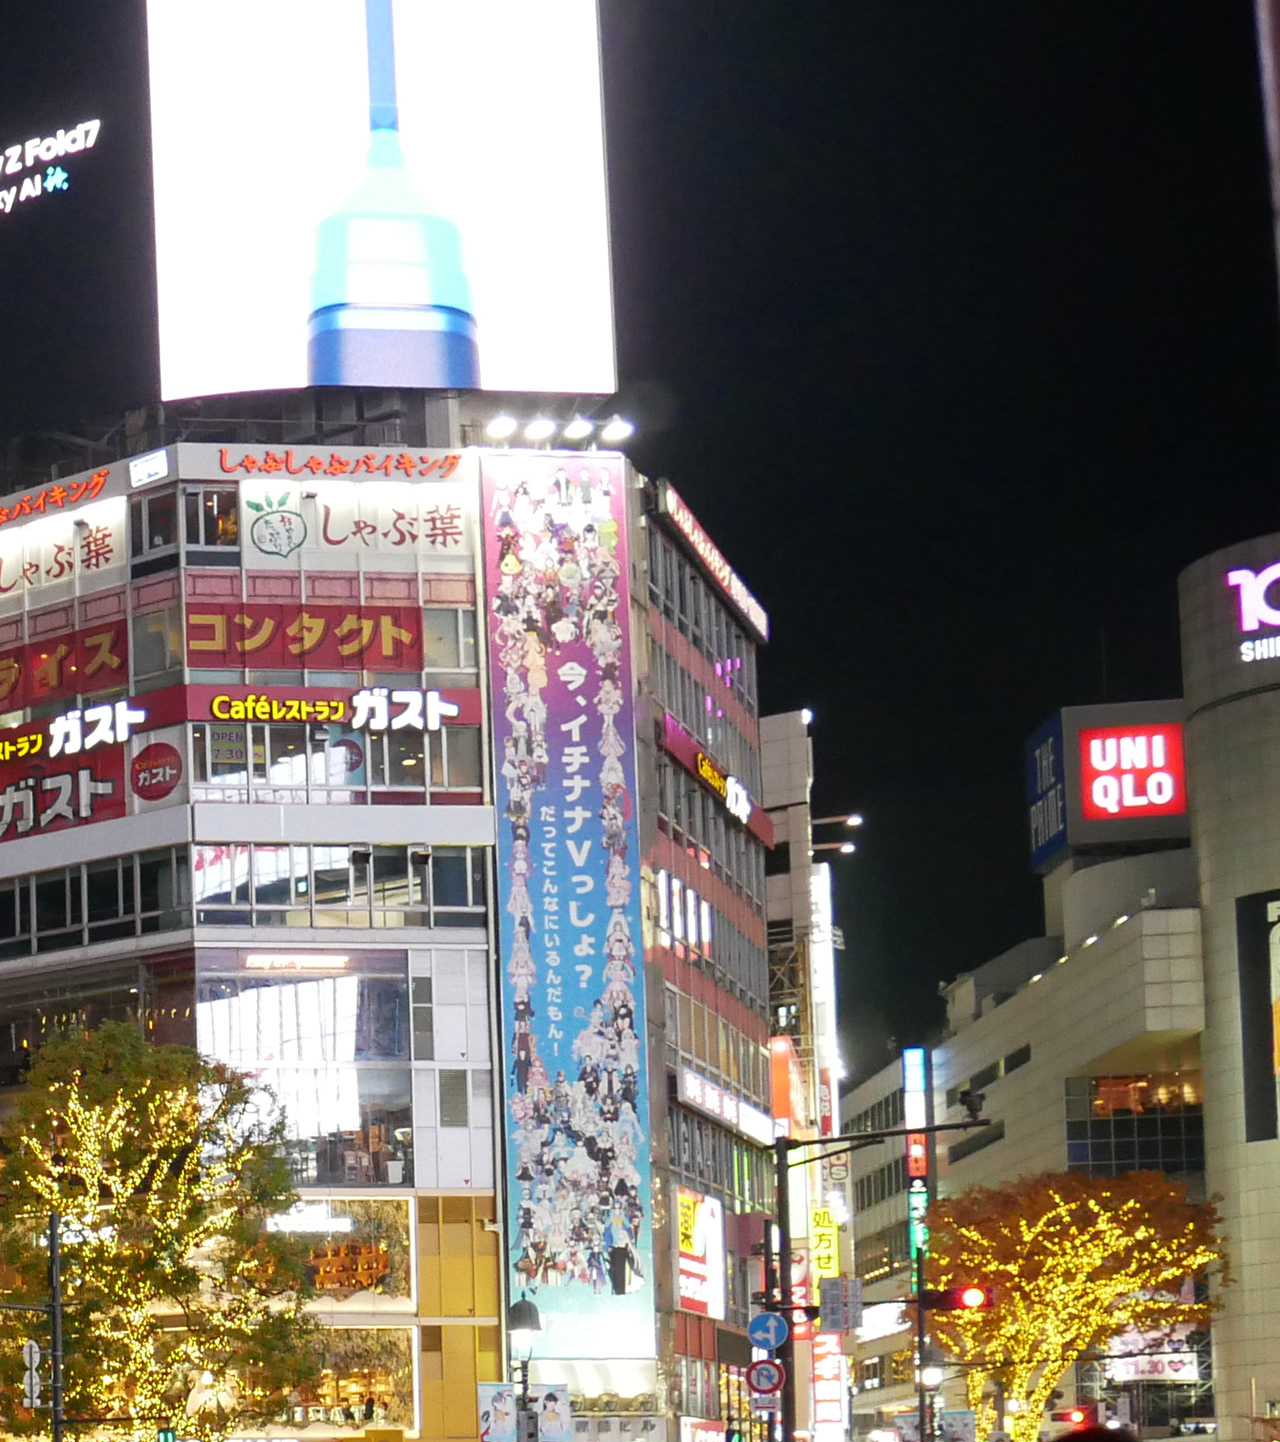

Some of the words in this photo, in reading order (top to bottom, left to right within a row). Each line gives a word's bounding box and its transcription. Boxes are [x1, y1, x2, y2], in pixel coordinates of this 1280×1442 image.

[5, 145, 23, 175] Z
[25, 119, 101, 167] Fold7
[19, 174, 42, 202] AI
[218, 446, 463, 479] しゃぶしゃぶバイキング
[322, 503, 464, 548] しゃぶ葉
[188, 613, 416, 656] コンタクト
[48, 700, 146, 758] ガスト
[211, 695, 346, 721] Caféレストラン
[352, 688, 460, 731] ガスト
[212, 730, 244, 743] OPEN
[1090, 735, 1166, 771] UNI
[138, 766, 178, 788] ガスト
[1092, 771, 1174, 814] QLO
[812, 1210, 834, 1289] 処方せ
